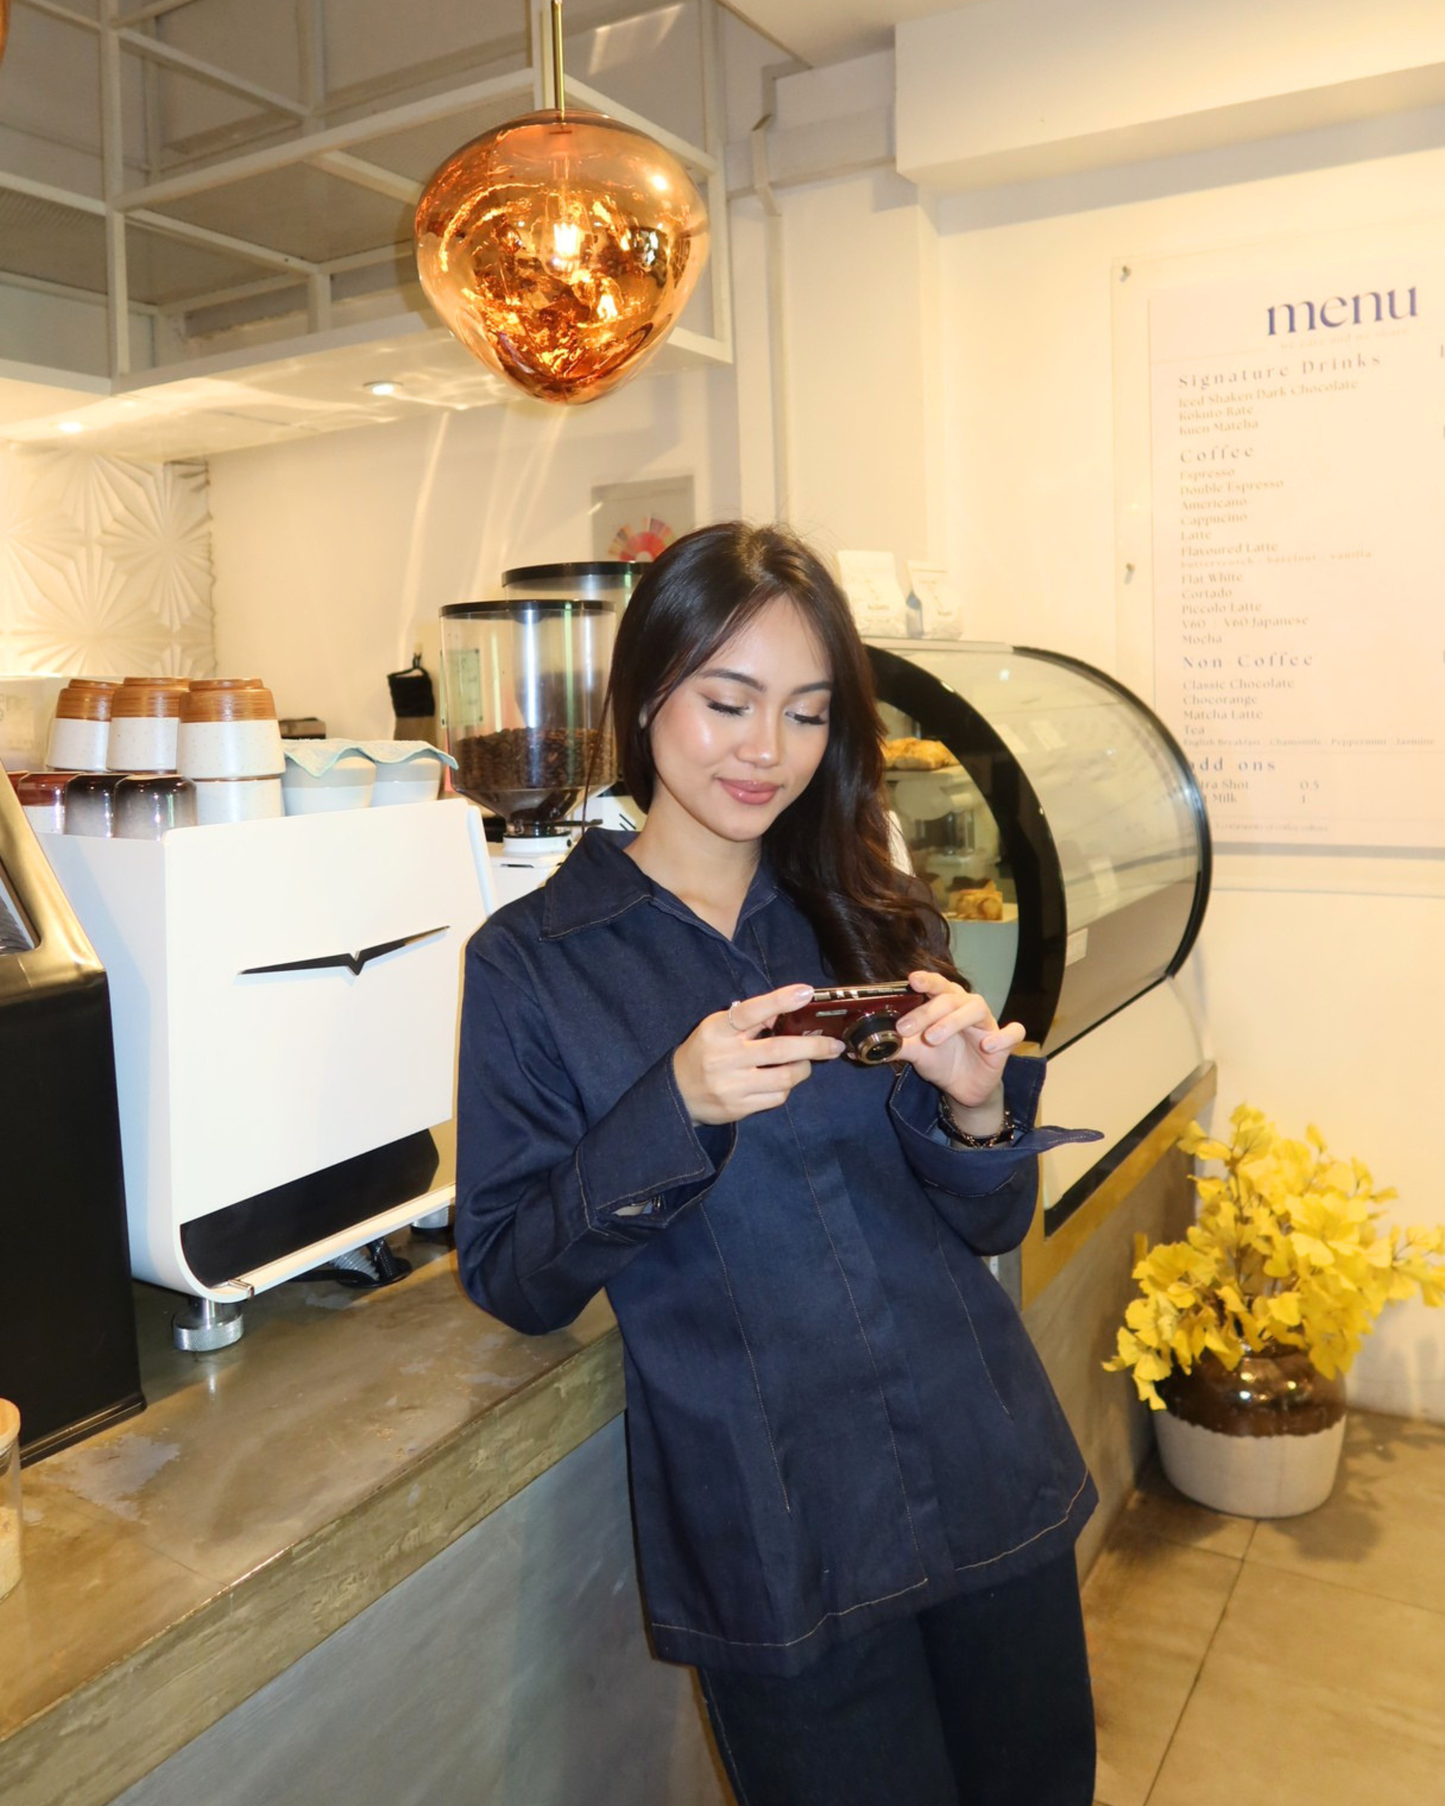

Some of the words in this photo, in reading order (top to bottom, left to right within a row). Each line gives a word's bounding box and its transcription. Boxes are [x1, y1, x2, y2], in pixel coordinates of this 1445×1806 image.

[1267, 286, 1419, 337] menu
[1178, 364, 1290, 390] Signature
[1301, 352, 1382, 376] Drinks
[1178, 396, 1205, 408] Iced
[1208, 391, 1254, 405] Shaken
[1256, 386, 1287, 399] Dark
[1290, 378, 1359, 396] Chocolate
[1214, 419, 1259, 432] Matcha
[1180, 445, 1255, 463] Coffee
[1180, 467, 1236, 481] Espresso
[1180, 482, 1223, 496] Double
[1227, 479, 1284, 493] Espresso
[1180, 497, 1248, 511] Americano
[1180, 512, 1248, 527] Cappucino
[1181, 530, 1212, 542] Latte
[1181, 543, 1242, 557] Flavoured
[1246, 542, 1279, 554] Latte
[1330, 550, 1372, 560] vanilla
[1181, 573, 1204, 585] Flat
[1208, 572, 1244, 583] White
[1181, 587, 1233, 600] Cortado
[1181, 602, 1227, 615] Piccolo
[1230, 601, 1262, 612] Latte
[1251, 616, 1309, 629] Japanese
[1182, 633, 1223, 645] Mocha
[1183, 655, 1223, 669] Non
[1237, 651, 1314, 667] Coffee
[1182, 678, 1226, 690] Classic
[1230, 677, 1295, 689] Chocolate
[1182, 695, 1258, 707] Chocorange
[1183, 709, 1228, 720] Matcha
[1231, 709, 1264, 720] Latte
[1184, 724, 1206, 736] Tea
[1238, 760, 1276, 772] ons
[1200, 779, 1218, 790] tra
[1222, 778, 1249, 790] Shot
[1299, 779, 1320, 790] 0.5
[1212, 792, 1237, 804] Milk
